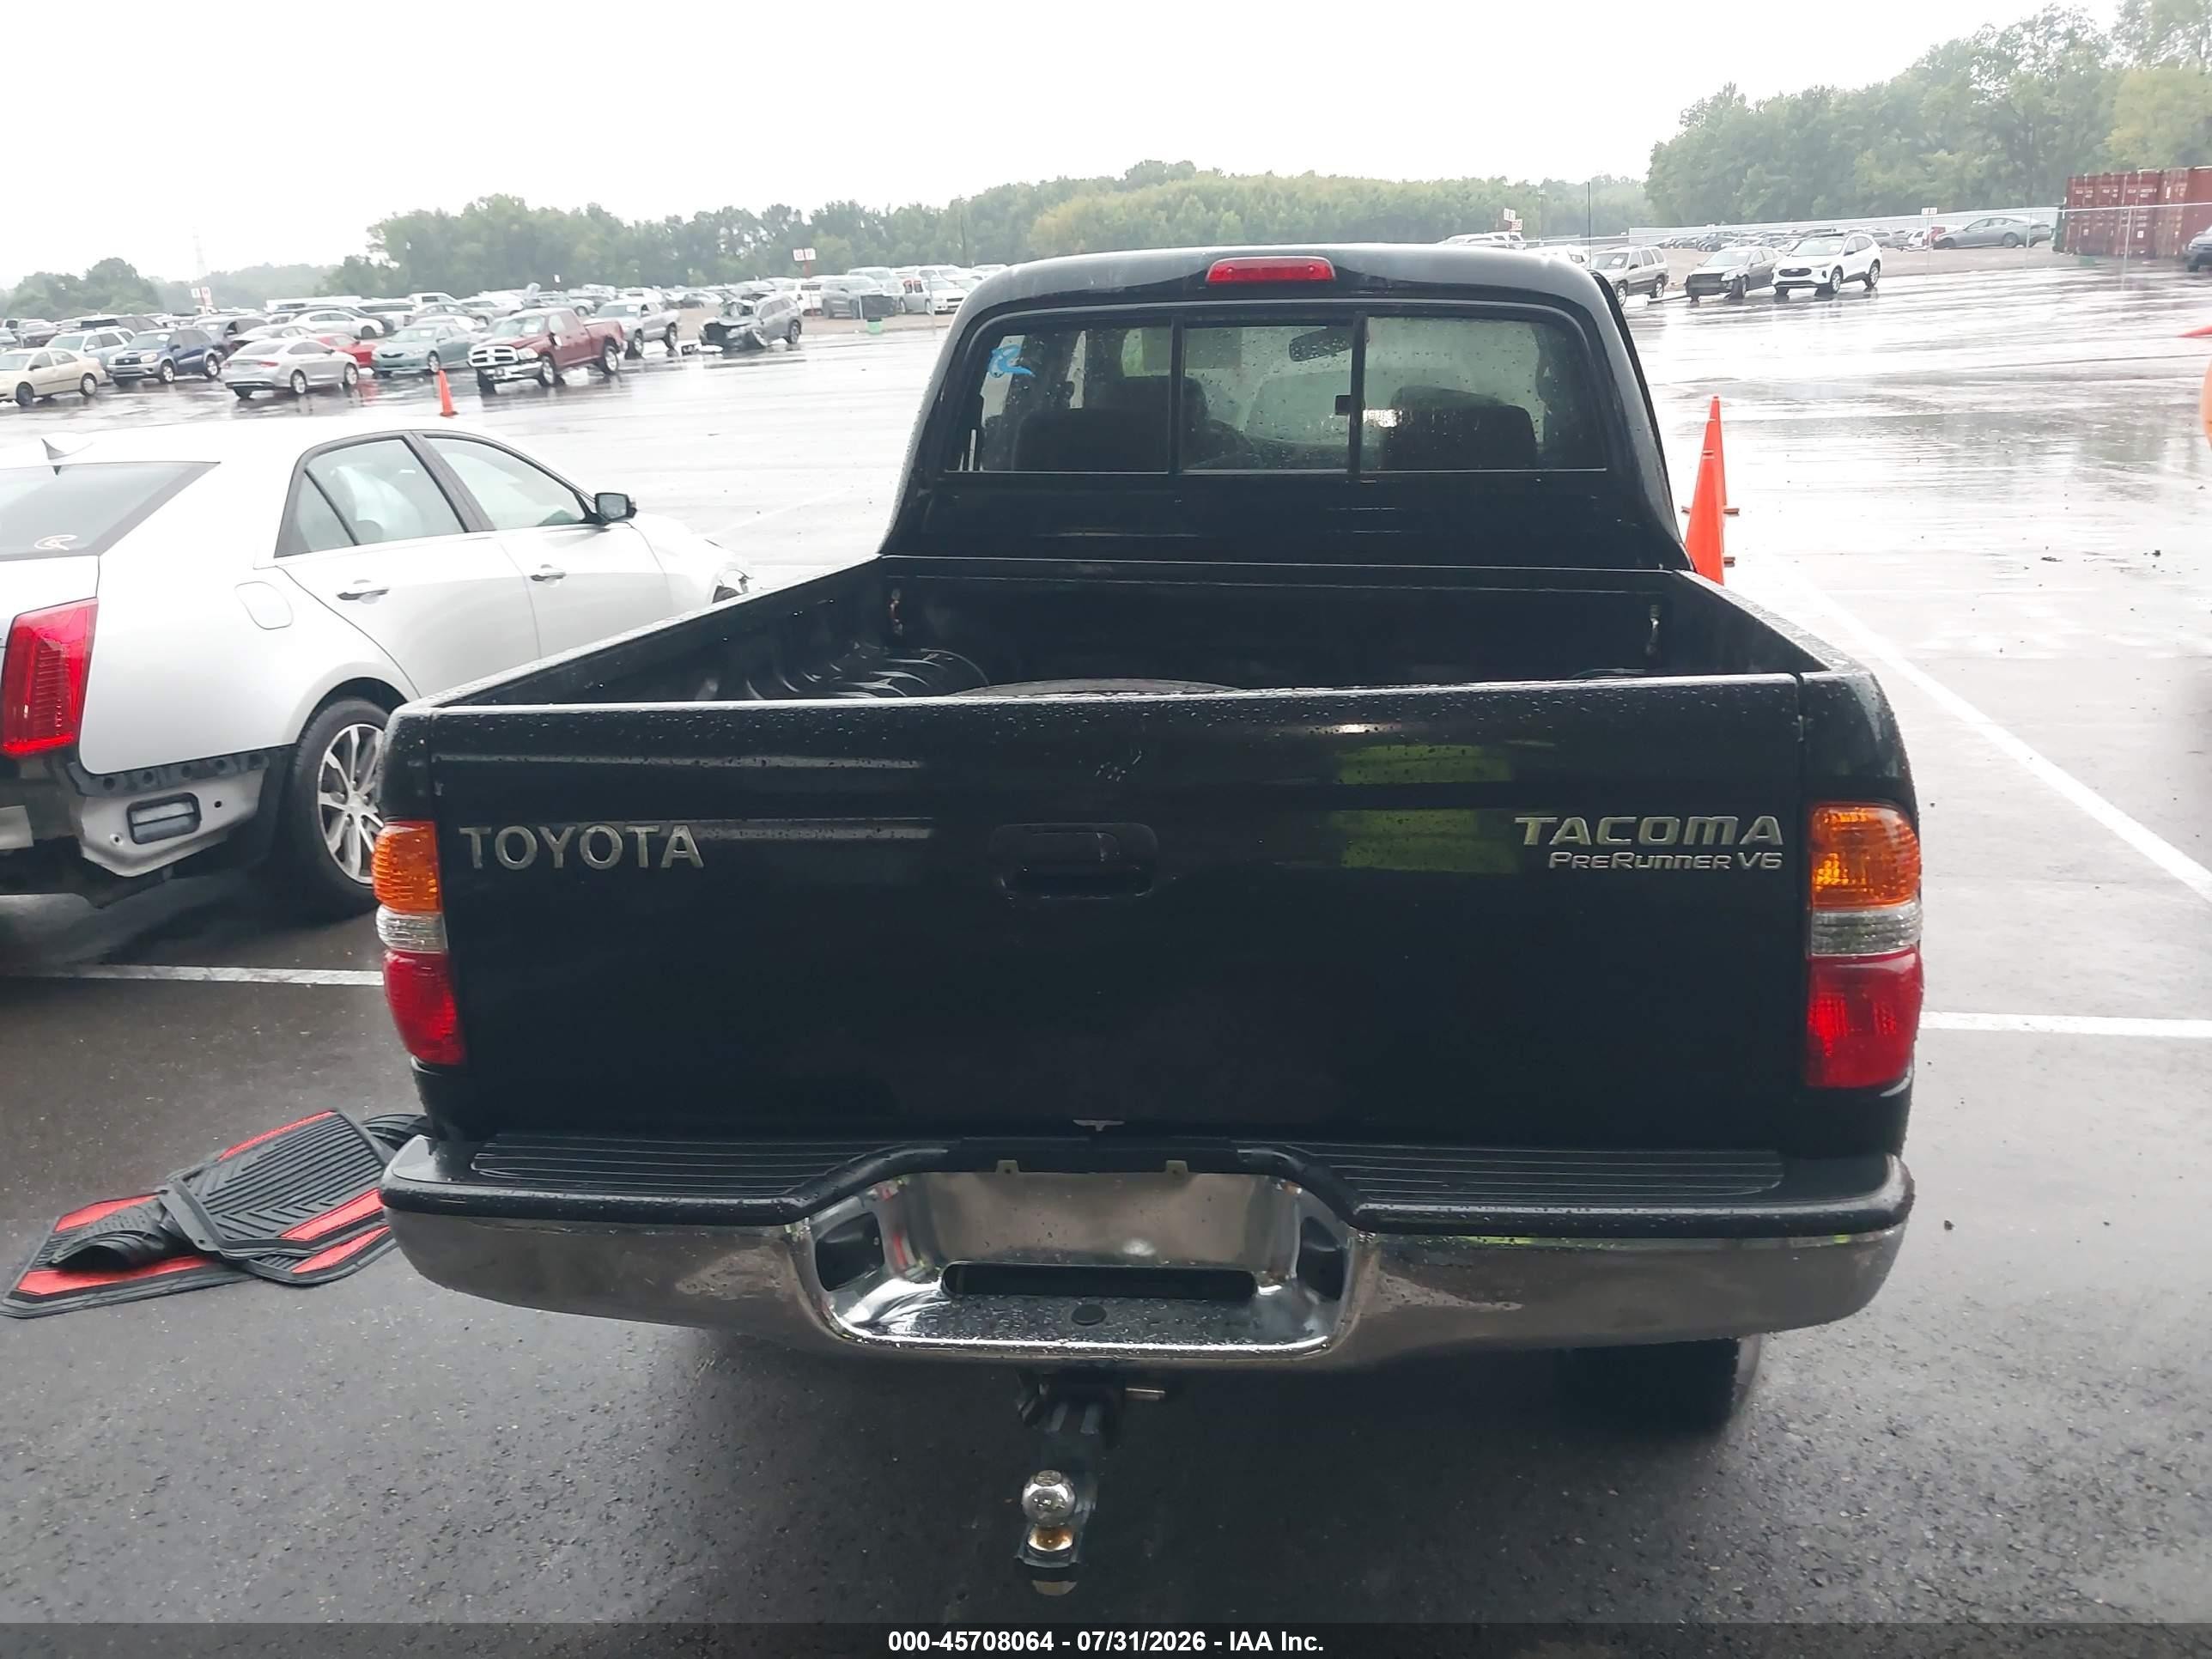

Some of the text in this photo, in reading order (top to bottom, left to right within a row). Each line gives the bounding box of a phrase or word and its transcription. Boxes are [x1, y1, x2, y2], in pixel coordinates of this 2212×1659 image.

[1514, 816, 1784, 846] TACOMA
[459, 824, 704, 870] TOYOTA
[1737, 852, 1784, 870] V6
